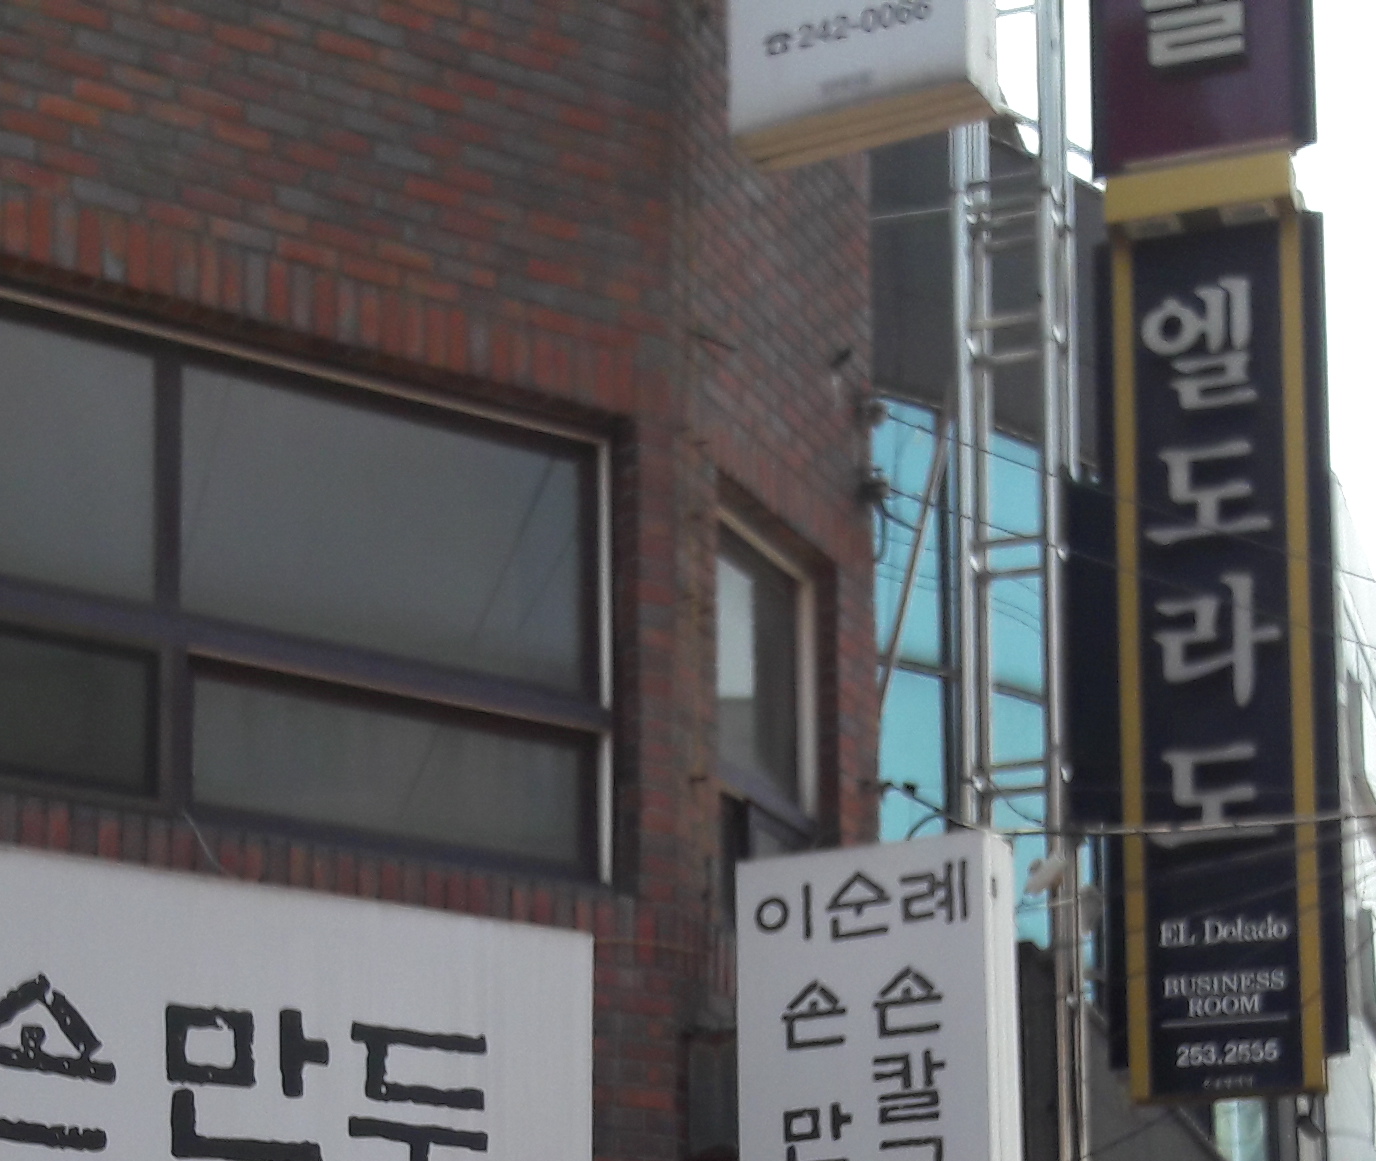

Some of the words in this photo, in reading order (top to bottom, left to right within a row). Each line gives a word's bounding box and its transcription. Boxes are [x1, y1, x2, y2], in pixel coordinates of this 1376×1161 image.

[1141, 276, 1281, 848] 엘도라도
[755, 858, 968, 944] 이순례
[1159, 921, 1196, 947] EL
[1163, 968, 1286, 998] BUSINESS
[1188, 993, 1262, 1018] ROOM
